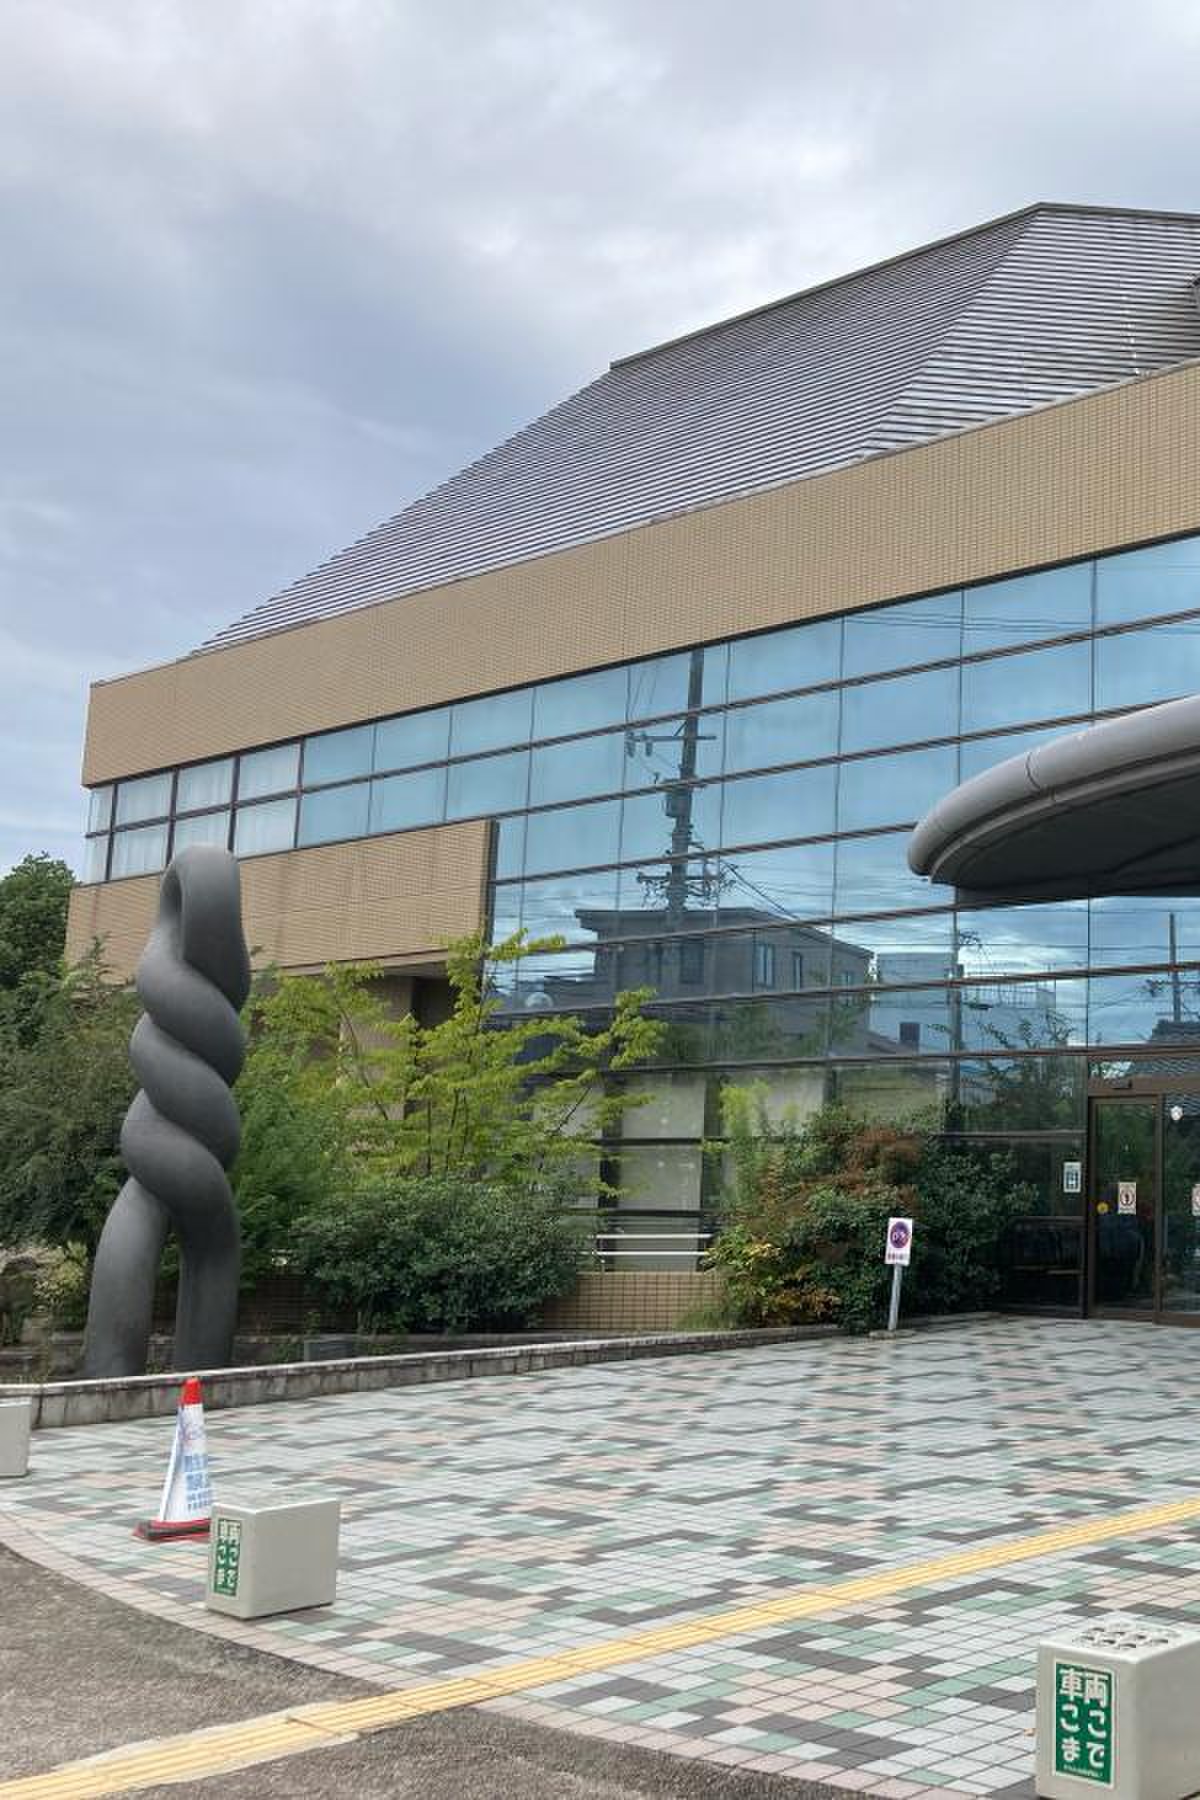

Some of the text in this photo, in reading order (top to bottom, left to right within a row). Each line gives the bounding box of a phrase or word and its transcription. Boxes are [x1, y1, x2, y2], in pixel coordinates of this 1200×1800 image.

[1059, 1667, 1109, 1707] 車両
[1060, 1704, 1107, 1738] ここ
[1061, 1737, 1105, 1768] まで
